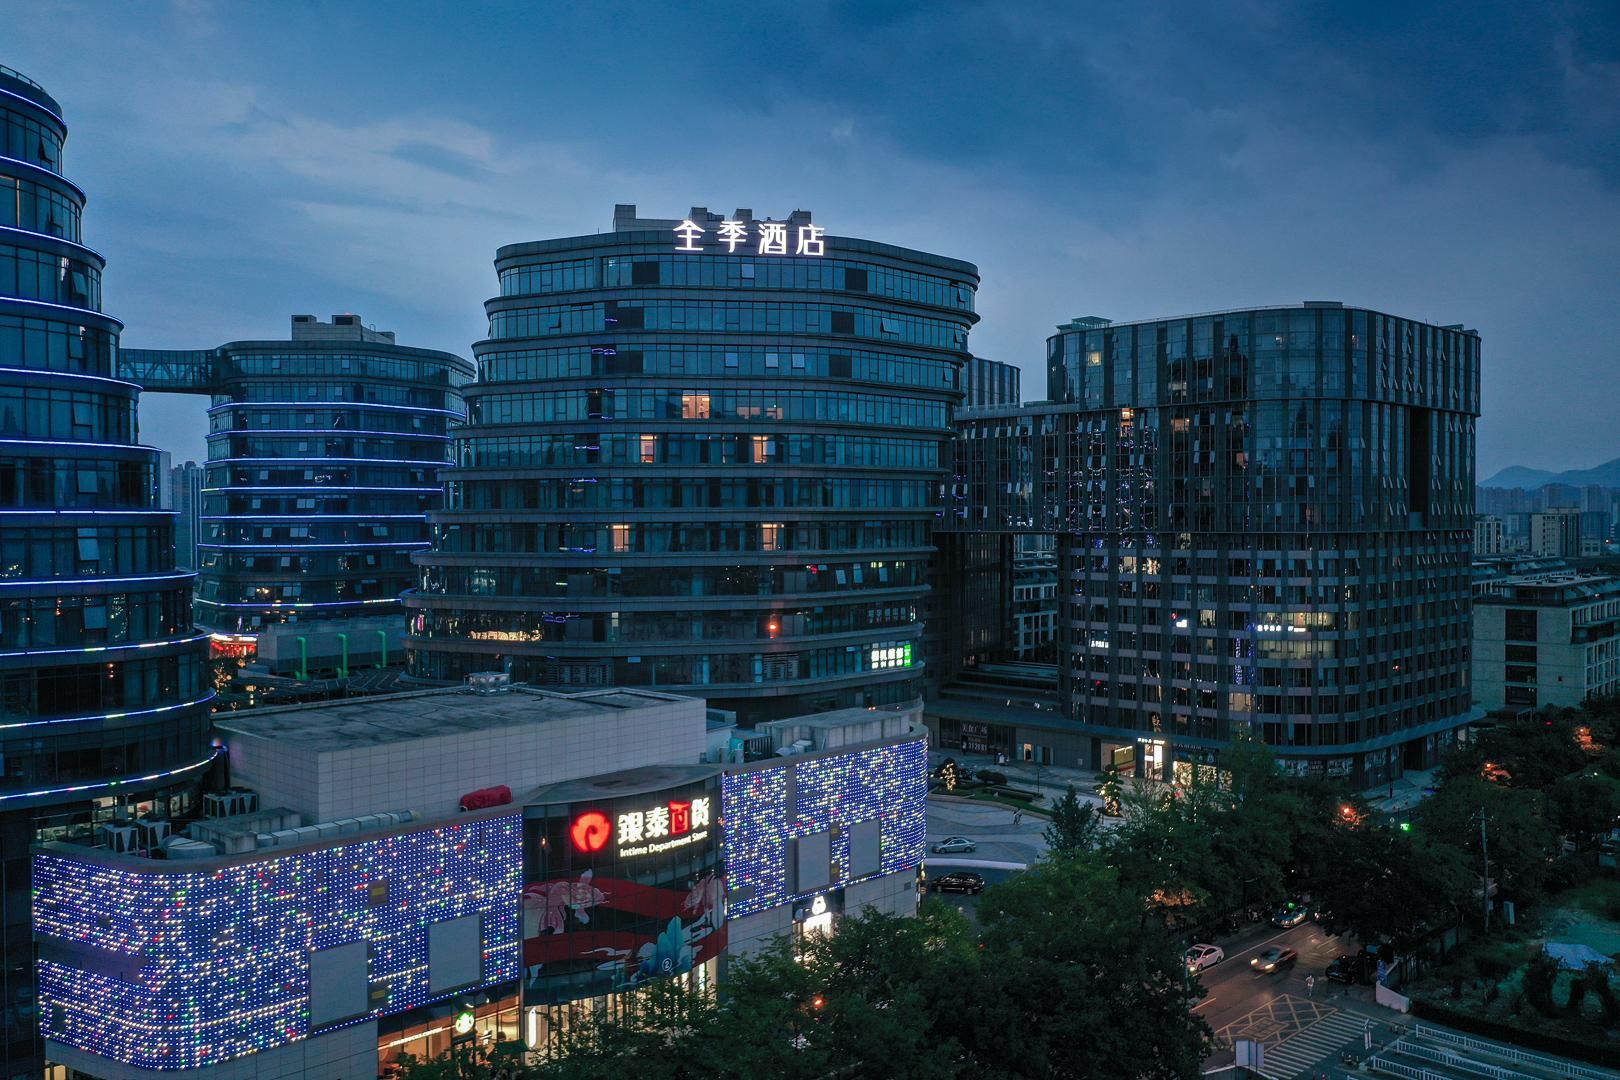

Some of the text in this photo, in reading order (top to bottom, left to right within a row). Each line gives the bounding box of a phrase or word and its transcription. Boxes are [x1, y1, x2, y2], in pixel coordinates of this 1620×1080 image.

[672, 219, 825, 256] 全季酒店
[620, 830, 708, 857] Intime Department Store
